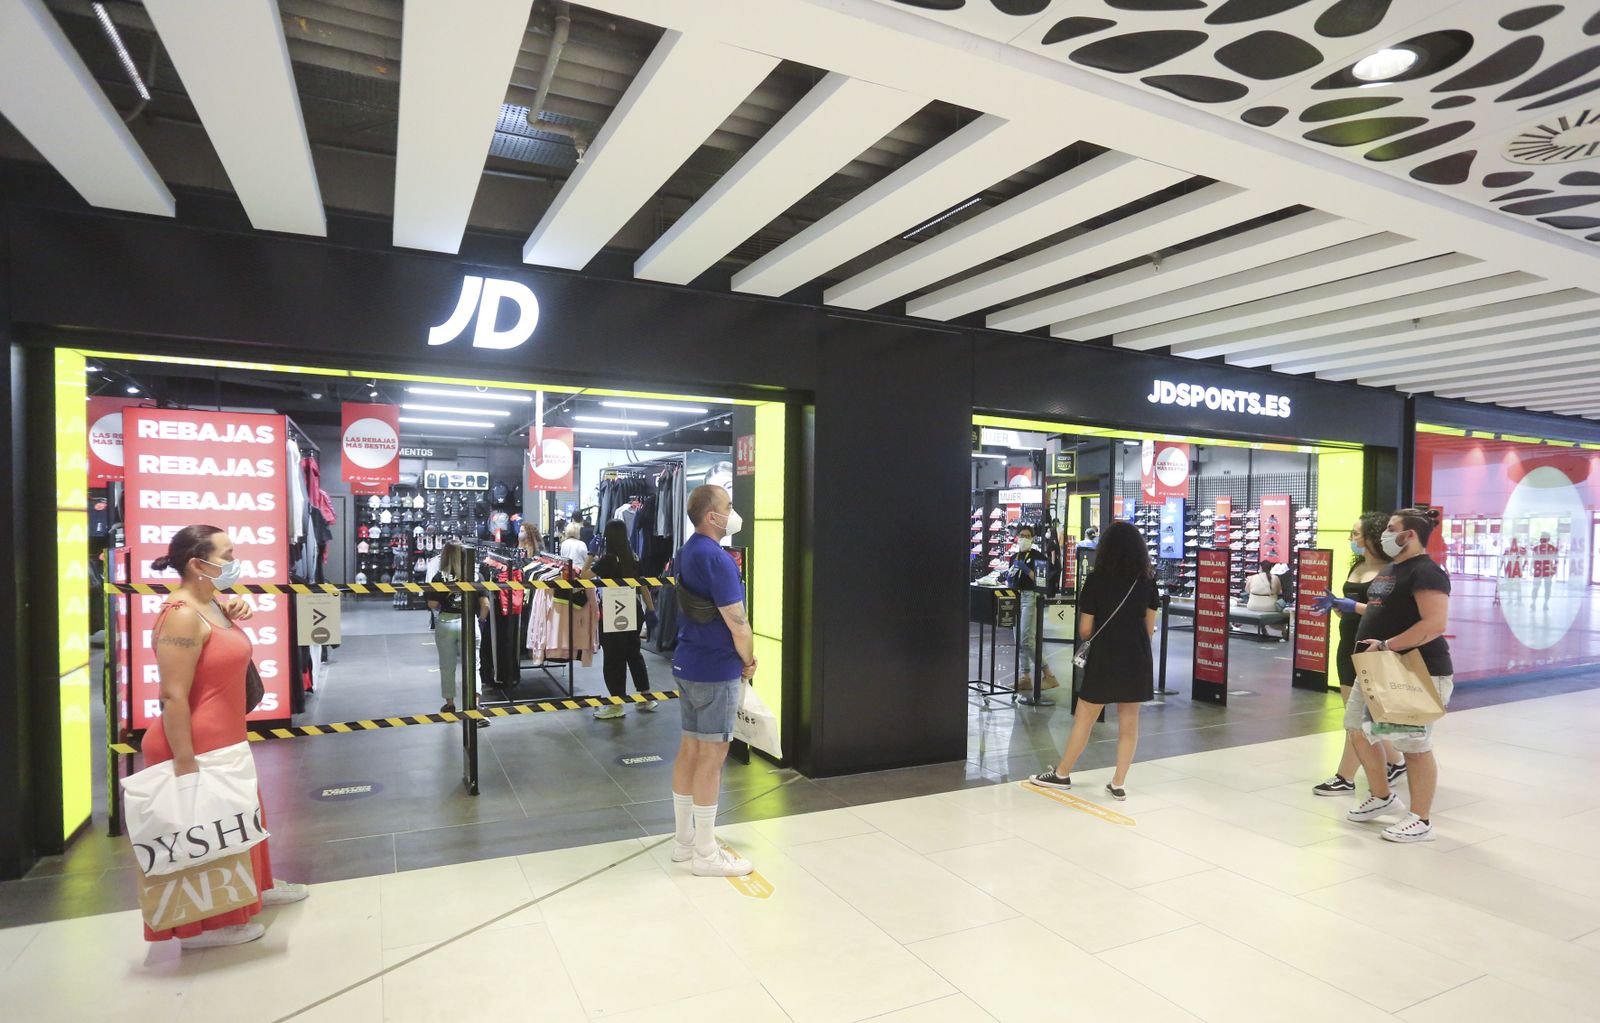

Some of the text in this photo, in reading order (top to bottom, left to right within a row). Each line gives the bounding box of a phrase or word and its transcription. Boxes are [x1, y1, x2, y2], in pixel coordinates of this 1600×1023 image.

[428, 275, 539, 350] JD
[1147, 380, 1291, 418] JDSPORTS.ES
[137, 419, 274, 444] REBAJAS
[138, 454, 275, 478] REBAJAS
[139, 489, 276, 511] REBAJAS
[1199, 576, 1225, 584] REBAJAS
[1300, 574, 1327, 582] REBAJAS
[1199, 593, 1224, 601] REBAJAS
[1198, 610, 1224, 618] REBAJAS
[1299, 619, 1325, 628] REBAJAS
[1198, 626, 1224, 634] REBAJAS
[1298, 634, 1324, 642] REBAJAS
[1197, 641, 1223, 650] REBAJAS
[1297, 649, 1324, 658] REBAJAS
[1197, 658, 1223, 667] REBAJAS
